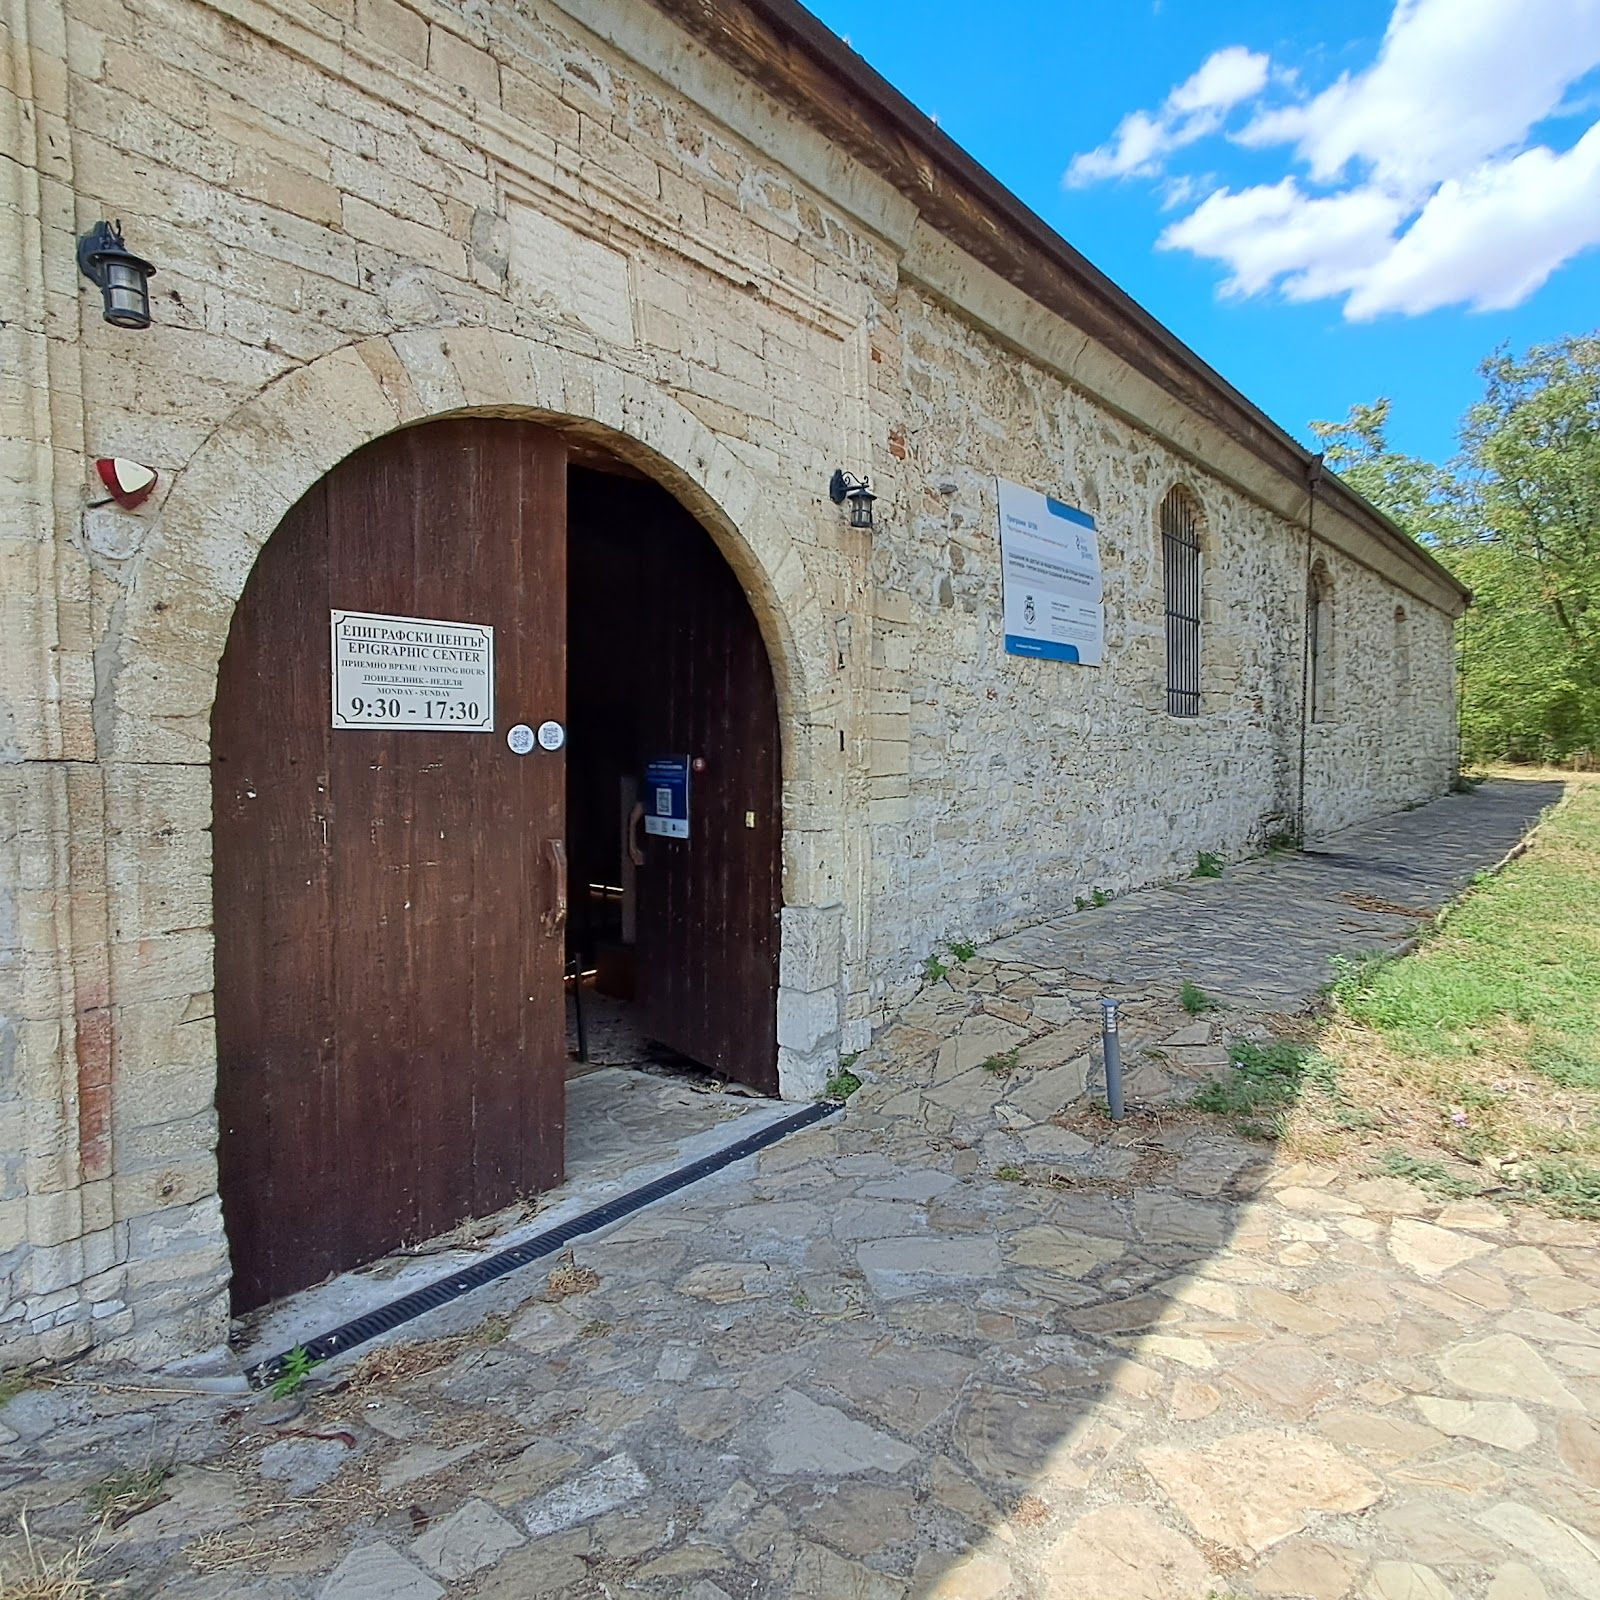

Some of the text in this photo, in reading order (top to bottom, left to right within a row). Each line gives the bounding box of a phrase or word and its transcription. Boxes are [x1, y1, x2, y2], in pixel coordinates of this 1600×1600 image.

[343, 625, 485, 648] ЕПИГРАФСКИ ЦЕНТЪР
[349, 642, 480, 663] EPIGRAPHIC CENTER
[341, 659, 387, 669] ПРИЕМНО
[389, 662, 417, 671] ВРЕМЕ
[423, 665, 458, 675] VISITING
[460, 668, 486, 676] HOURS
[363, 674, 424, 685] ПОНЕДЕЛНИК
[430, 678, 462, 687] НЕДЕЛЯ
[377, 687, 413, 696] MONDAY
[419, 689, 451, 697] SUNDAY
[351, 697, 401, 718] 9:30
[424, 700, 479, 721] 17:30
